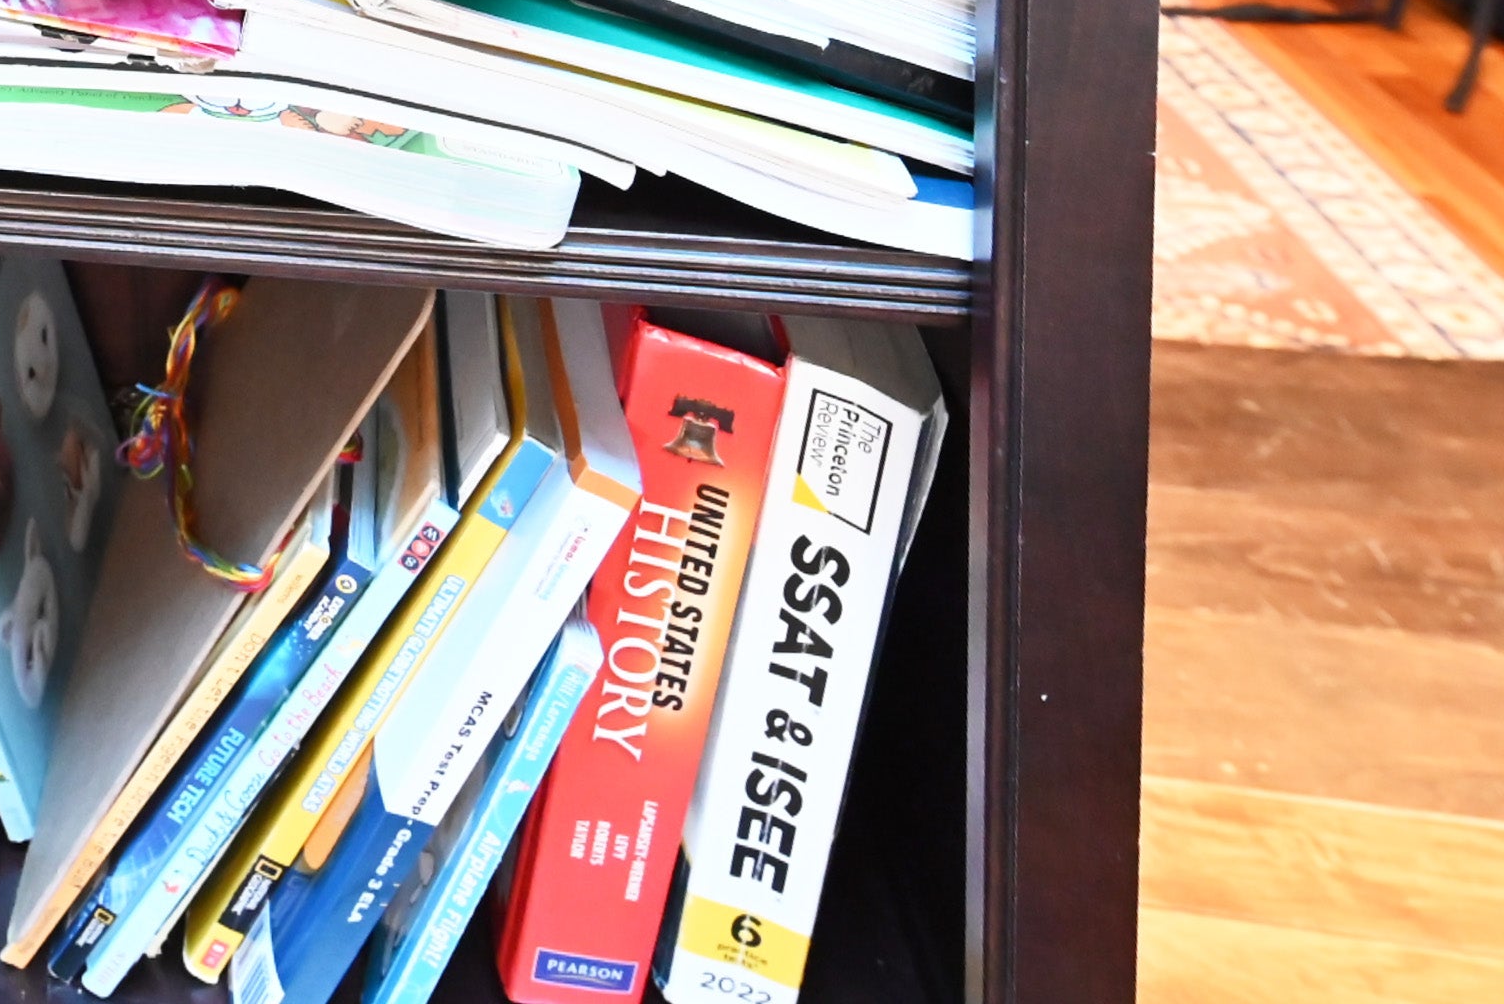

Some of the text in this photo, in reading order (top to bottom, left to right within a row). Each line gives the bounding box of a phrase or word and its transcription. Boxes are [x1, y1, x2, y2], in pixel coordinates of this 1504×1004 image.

[812, 398, 838, 469] Review
[825, 406, 861, 498] Princeton
[857, 416, 882, 455] The
[592, 500, 693, 761] HISTORY
[651, 483, 731, 712] UNITED STATES
[254, 741, 282, 768] Go
[270, 725, 293, 746] to
[282, 701, 312, 731] the
[299, 659, 342, 708] Beach
[298, 572, 466, 815] ULTIMATE GLOBETROTTING WORLD ATLAS
[729, 535, 851, 895] SSAT & ISEE
[164, 725, 245, 826] FUTURE TECH
[345, 688, 494, 928] MCAS Test Prep Grade 3 ELA
[570, 819, 590, 861] TAYLOR
[590, 820, 611, 866] ROBERTS
[613, 833, 630, 861] LEVY
[417, 830, 504, 970] Airplane Flight!
[730, 913, 763, 948] 6
[547, 958, 624, 982] PEARSON
[700, 971, 772, 1004] 2022
